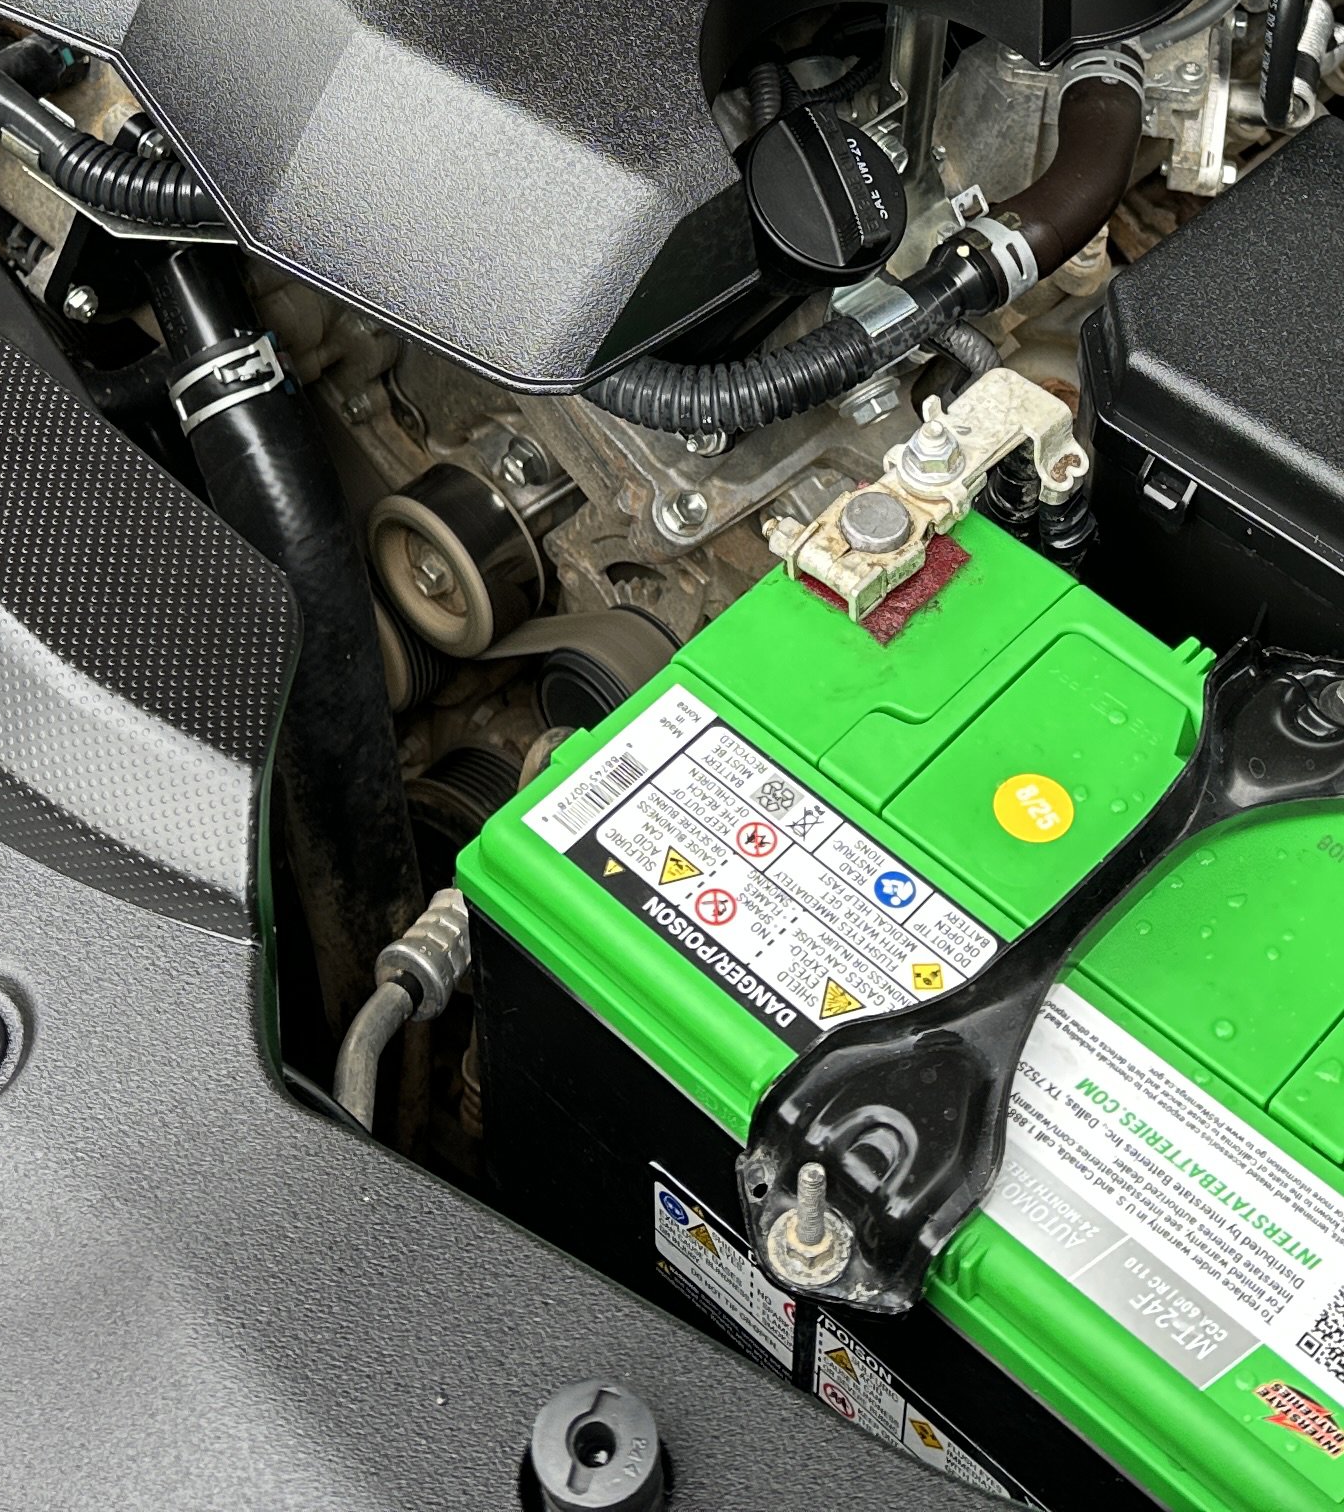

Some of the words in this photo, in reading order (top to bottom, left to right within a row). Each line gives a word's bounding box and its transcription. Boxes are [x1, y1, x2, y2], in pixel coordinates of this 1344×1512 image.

[674, 714, 686, 724] in
[676, 702, 702, 724] Korea
[660, 716, 684, 738] Made
[712, 744, 728, 758] BE
[702, 754, 744, 788] BATTERY
[724, 756, 754, 780] MUST
[670, 788, 686, 800] OF
[686, 782, 722, 812] REACH
[688, 768, 736, 806] CHILDREN
[648, 792, 680, 820] BURNS
[682, 798, 706, 816] OUT
[718, 808, 740, 828] THE
[734, 806, 750, 818] OF
[1013, 782, 1061, 829] 8/25
[636, 800, 688, 842] BLINDNESS
[642, 822, 664, 840] CAN
[678, 816, 714, 846] SEVERE
[704, 816, 732, 836] KEEP
[604, 828, 656, 872] SULFURIC
[632, 834, 662, 856] ACID
[684, 840, 716, 866] CAUSE
[710, 842, 726, 858] OR
[854, 840, 886, 868] TIONS
[818, 872, 846, 894] FAST
[838, 862, 868, 886] READ
[744, 882, 784, 916] FLAMES
[746, 870, 796, 908] SMOKING
[774, 872, 840, 924] IMMEDIATELY
[820, 892, 842, 910] GET
[732, 892, 774, 926] SPARKS
[842, 894, 872, 916] HELP
[750, 922, 772, 940] NO
[792, 928, 826, 956] CAUSE
[838, 922, 866, 946] EYES
[872, 912, 918, 952] MEDICAL
[912, 924, 932, 938] TIP
[934, 920, 964, 946] OPEN
[944, 912, 990, 948] BATTERY
[818, 932, 854, 962] INJURY
[862, 942, 898, 972] FLUSH
[878, 936, 908, 962] WITH
[930, 936, 956, 956] NOT
[962, 942, 980, 958] OR
[642, 896, 808, 1028] DANGER/POISON
[824, 954, 848, 974] CAN
[852, 958, 868, 972] OR
[954, 952, 972, 968] DO
[776, 970, 820, 1007] SHIELD
[844, 972, 886, 1006] GASES
[1062, 1024, 1096, 1054] including
[1070, 1020, 1090, 1036] other
[1098, 1042, 1128, 1064] defects
[1096, 1052, 1134, 1082] chemicals
[1126, 1062, 1146, 1080] birth
[1044, 1082, 1062, 1100] TX
[1142, 1088, 1160, 1102] you
[1144, 1078, 1160, 1090] and
[1064, 1094, 1100, 1128] Dallas,
[1156, 1100, 1186, 1122] expose
[1160, 1090, 1188, 1110] cancer
[1186, 1110, 1210, 1130] cause
[1186, 1120, 1200, 1134] can
[1034, 1130, 1056, 1148] call
[1200, 1132, 1248, 1170] accessories
[1220, 1134, 1258, 1166] California
[1006, 1157, 1037, 1191] FREE
[1074, 1078, 1322, 1270] INTERSTATEBATTERIES.COM
[1124, 1144, 1174, 1186] Batteries
[1266, 1156, 1312, 1194] information
[1092, 1176, 1116, 1194] and
[1246, 1168, 1276, 1192] related
[1268, 1170, 1290, 1188] state
[1142, 1182, 1198, 1226] authorized
[1172, 1182, 1226, 1228] Interstate
[1272, 1190, 1292, 1204] and
[1288, 1188, 1304, 1200] the
[1312, 1192, 1334, 1210] more
[1032, 1178, 1100, 1241] 24-MONTH
[1136, 1210, 1148, 1222] in
[1292, 1202, 1330, 1234] terminals
[1312, 1206, 1340, 1230] known
[1164, 1214, 1184, 1232] see
[1226, 1224, 1242, 1242] by
[1146, 1218, 1192, 1256] warranty
[1194, 1224, 1244, 1264] Batteries
[1122, 1251, 1151, 1282] 110
[1190, 1254, 1222, 1280] under
[1240, 1236, 1306, 1290] Distributed
[1146, 1271, 1171, 1298] RC
[1222, 1278, 1262, 1312] replace
[1226, 1266, 1266, 1300] limited
[1242, 1260, 1294, 1304] Interstate
[1174, 1292, 1202, 1322] 600
[1260, 1308, 1274, 1326] To
[1264, 1296, 1286, 1314] For
[1126, 1292, 1218, 1360] MT-24F
[1198, 1313, 1229, 1344] CCA
[1256, 1383, 1342, 1457] INTERSTATE
